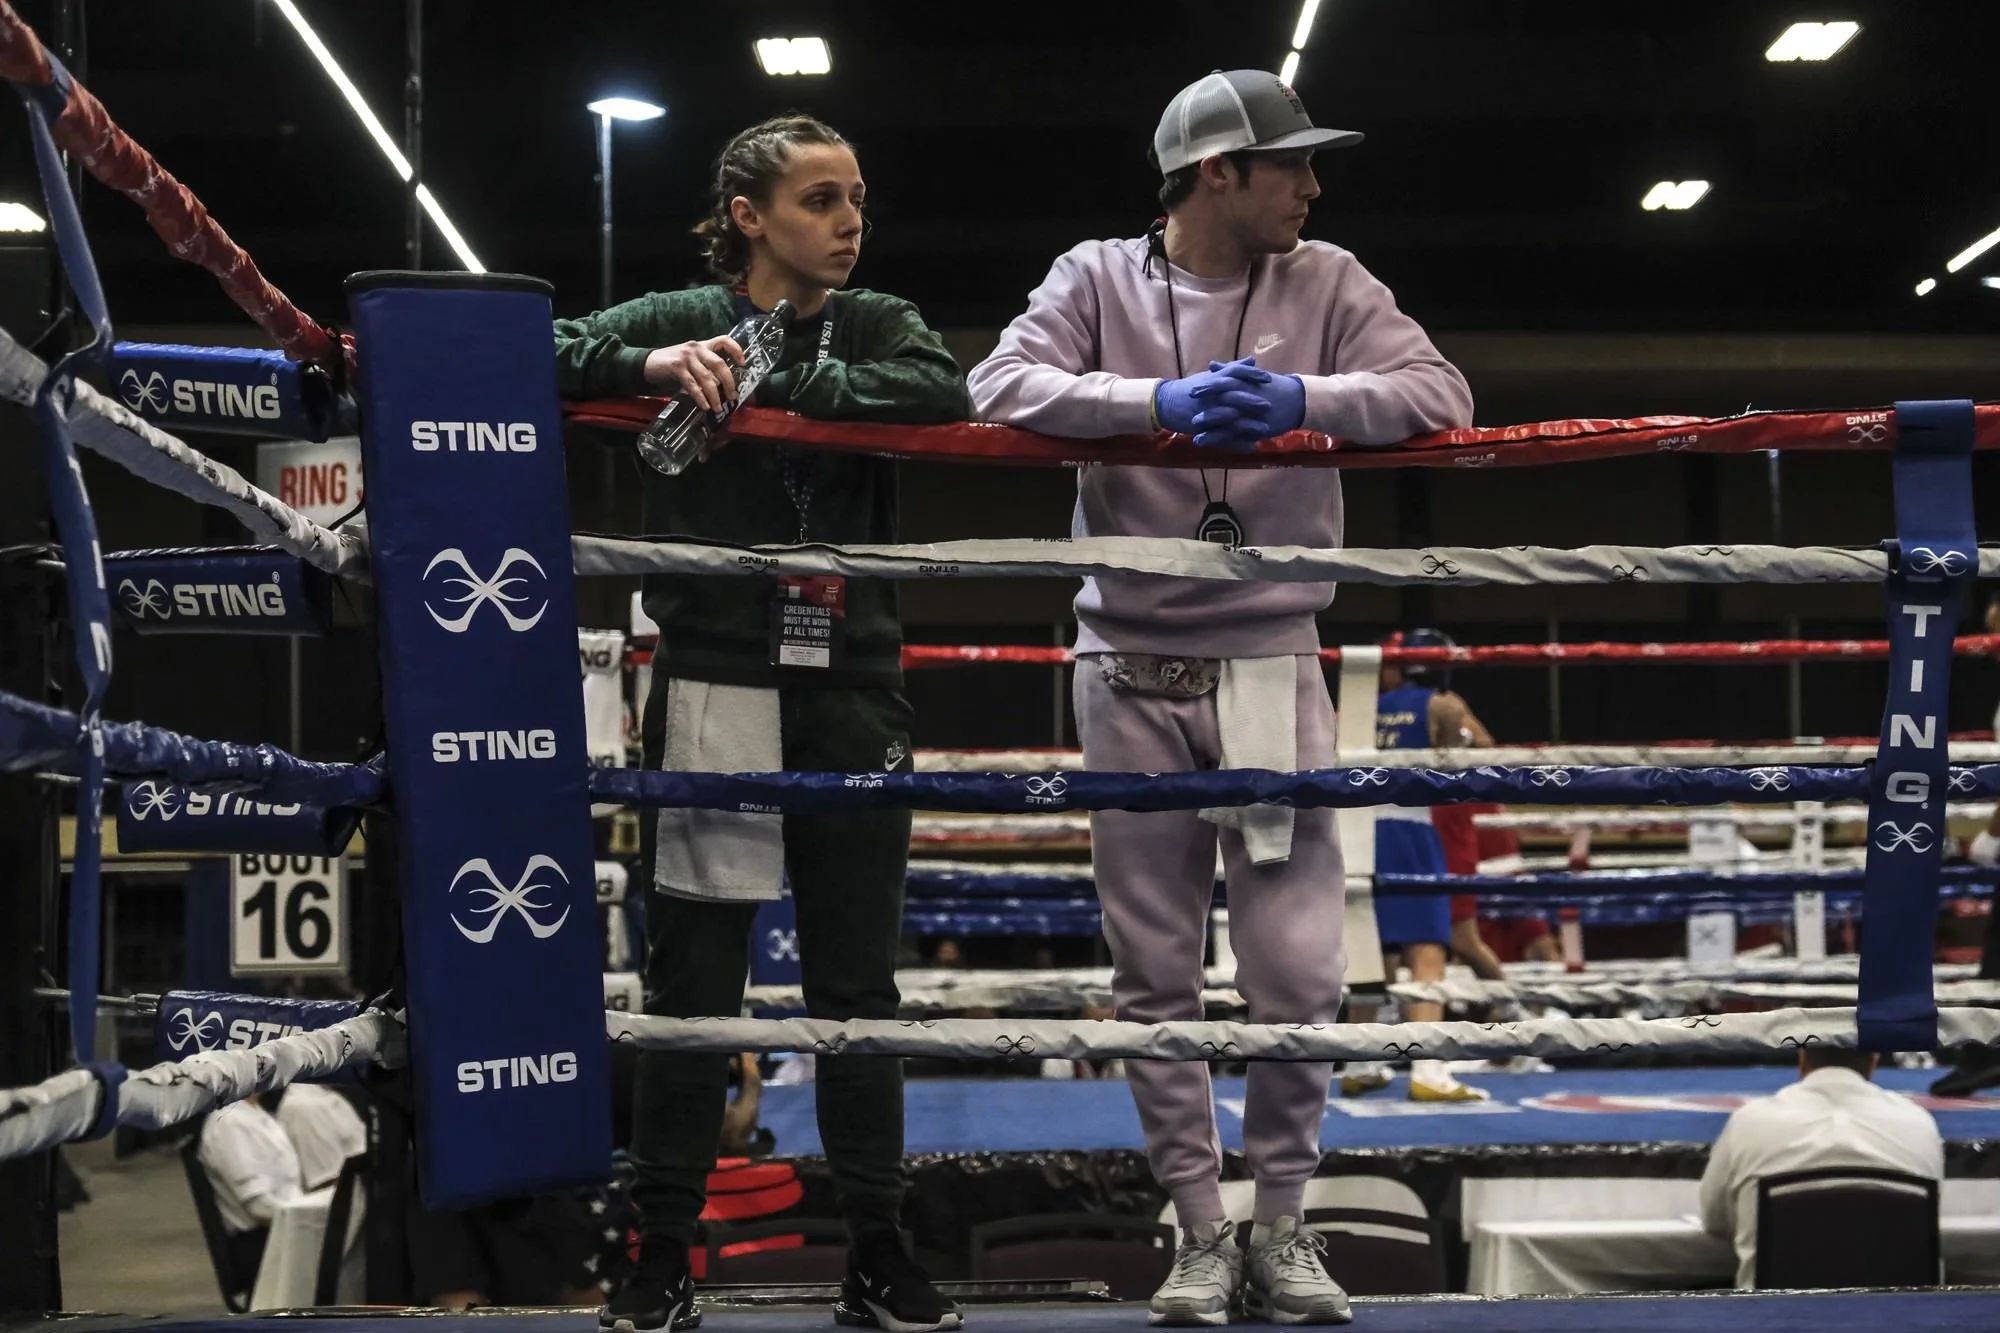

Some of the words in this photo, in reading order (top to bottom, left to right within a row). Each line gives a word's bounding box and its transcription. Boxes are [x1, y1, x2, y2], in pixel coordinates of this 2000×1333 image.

[820, 320, 833, 347] USA
[1846, 413, 1887, 425] STING
[411, 421, 537, 452] STING
[280, 462, 347, 508] RING
[919, 565, 959, 574] STING
[783, 605, 831, 617] CREDENTIALS
[783, 616, 801, 625] MUST
[802, 617, 811, 626] BE
[811, 618, 831, 627] WORN
[783, 626, 792, 635] AT
[793, 627, 807, 636] ALL
[808, 628, 831, 637] TIMES!
[432, 729, 557, 763] STING
[844, 779, 884, 788] STING
[243, 880, 332, 960] 16
[457, 1052, 578, 1093] STING
